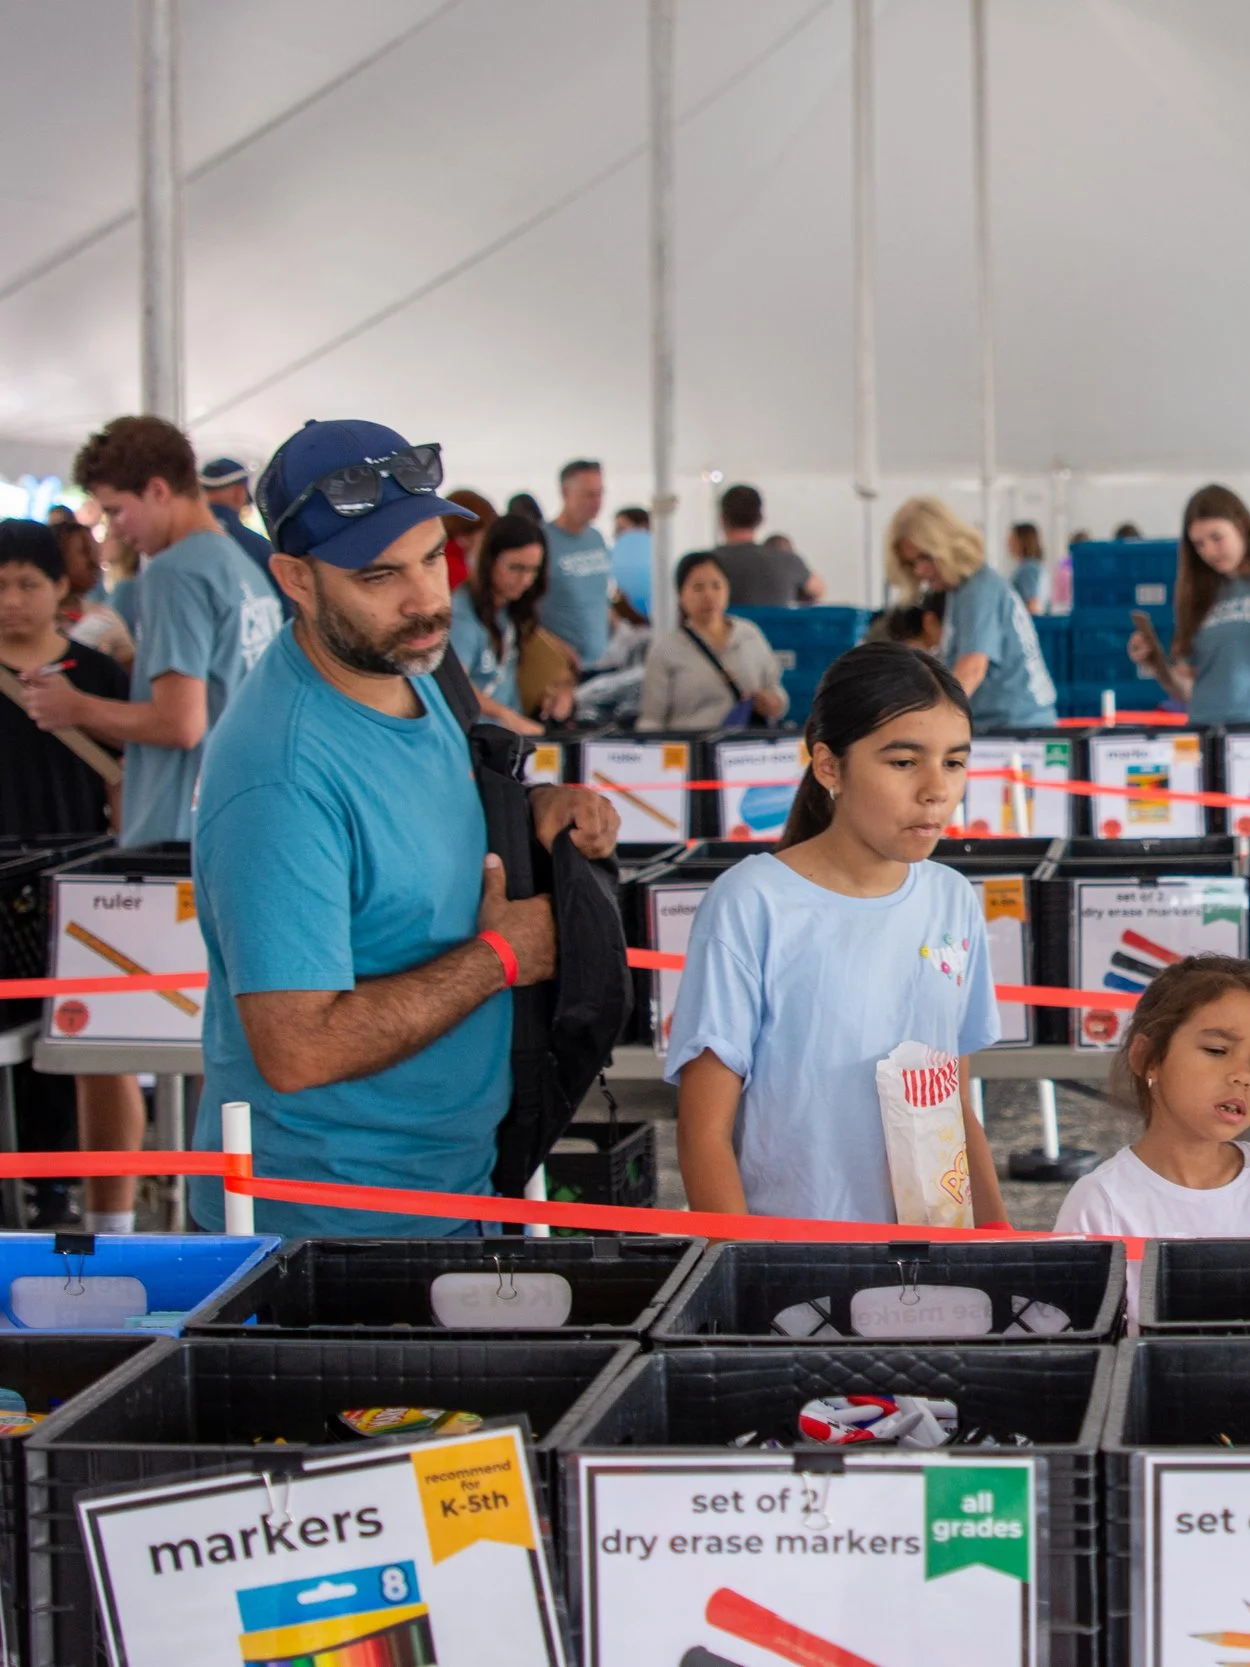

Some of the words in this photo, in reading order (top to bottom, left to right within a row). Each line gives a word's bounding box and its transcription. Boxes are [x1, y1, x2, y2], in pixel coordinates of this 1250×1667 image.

[93, 893, 142, 910] ruler
[1117, 892, 1136, 902] set
[1140, 892, 1153, 902] of
[425, 1459, 512, 1485] recommend
[460, 1479, 480, 1492] for
[441, 1491, 509, 1518] K-5th
[691, 1492, 744, 1514] set
[755, 1488, 792, 1514] of
[800, 1490, 820, 1514] 2
[960, 1491, 993, 1514] all
[933, 1517, 1023, 1542] grades
[1176, 1508, 1235, 1534] set
[148, 1506, 383, 1574] markers
[601, 1530, 657, 1561] dry
[668, 1534, 763, 1555] erase
[776, 1530, 920, 1555] markers
[380, 1564, 409, 1604] 8
